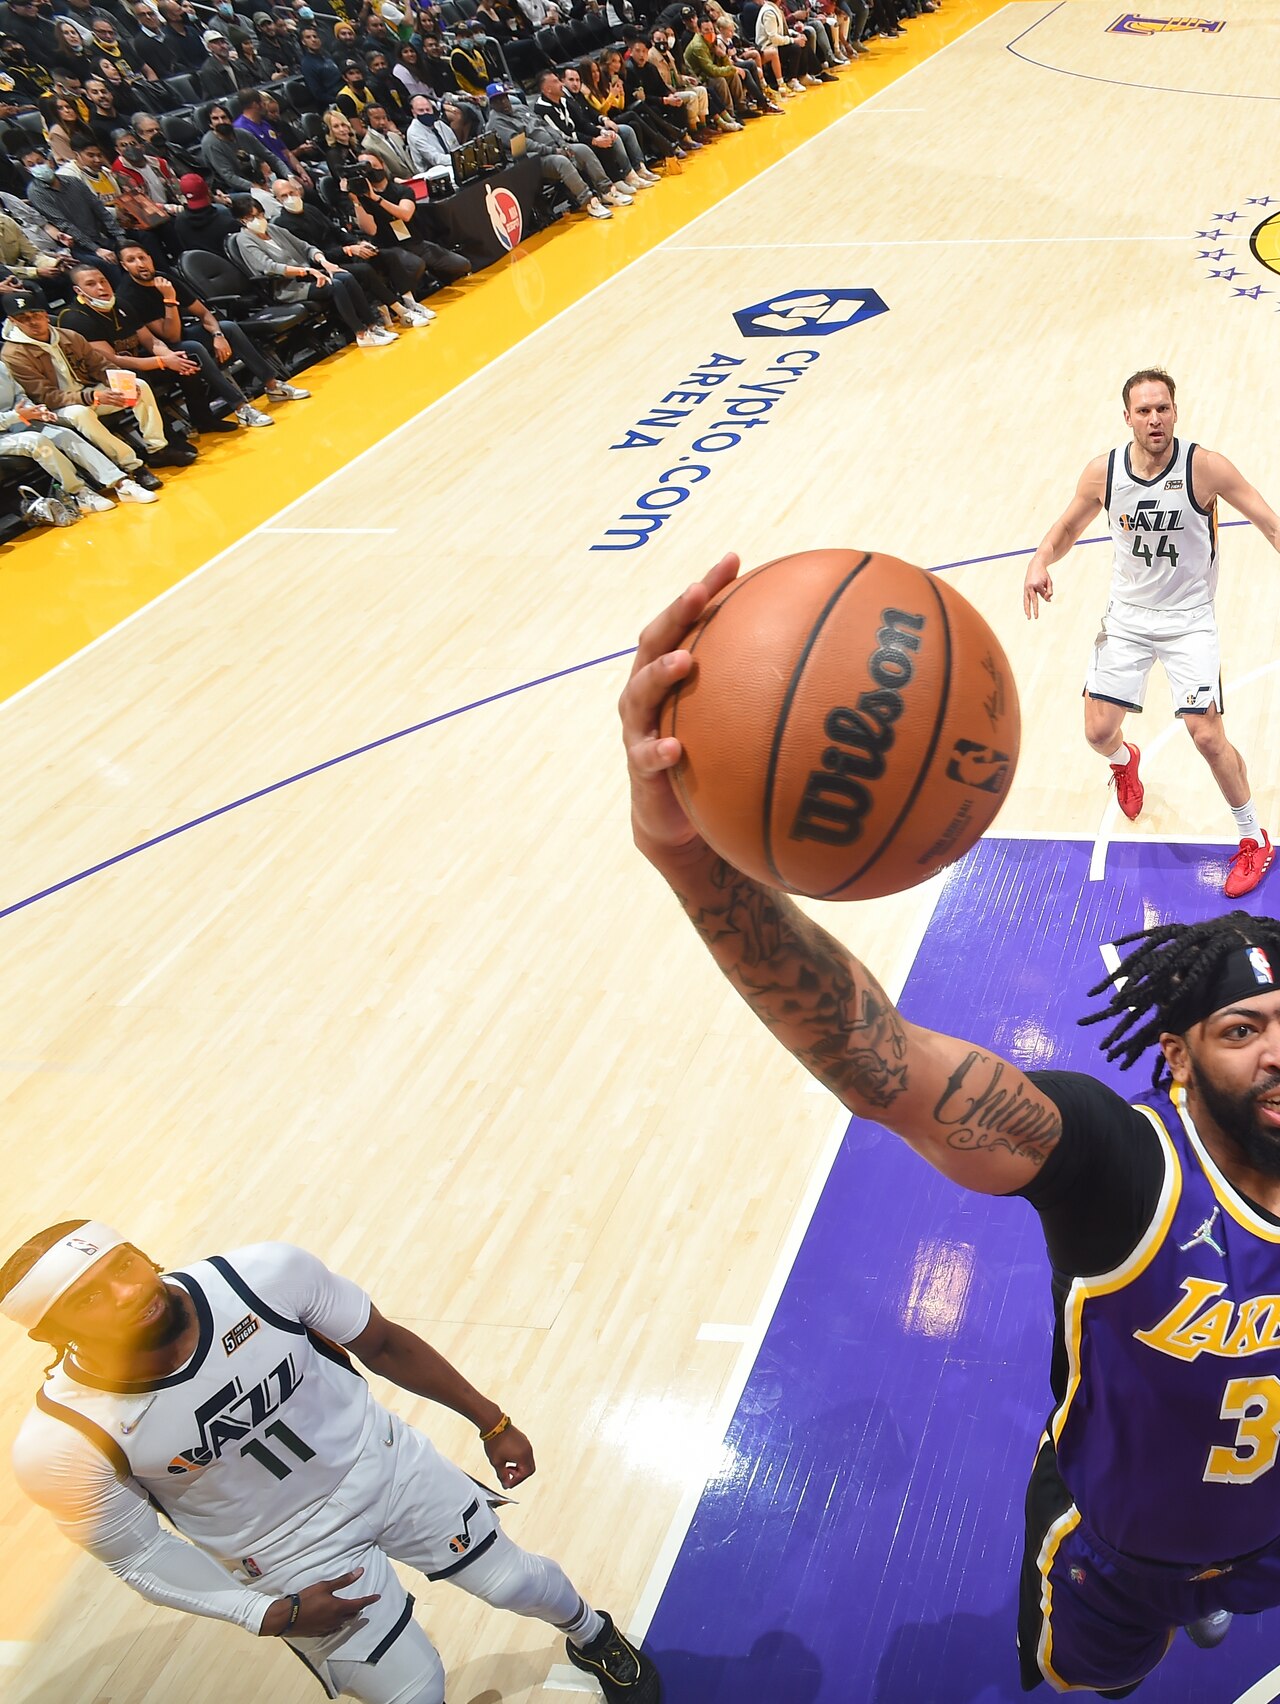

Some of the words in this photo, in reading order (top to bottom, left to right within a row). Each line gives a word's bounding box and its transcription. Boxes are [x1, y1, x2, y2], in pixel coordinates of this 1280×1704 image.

[608, 352, 747, 450] ARENA
[588, 349, 821, 551] crypto.com
[1119, 499, 1185, 532] JAZZ
[1131, 534, 1180, 568] 44
[788, 606, 927, 848] Wilson
[224, 1334, 236, 1352] 5
[237, 1322, 257, 1343] FIGHT
[167, 1351, 305, 1474] JAZZ
[239, 1418, 317, 1481] 11
